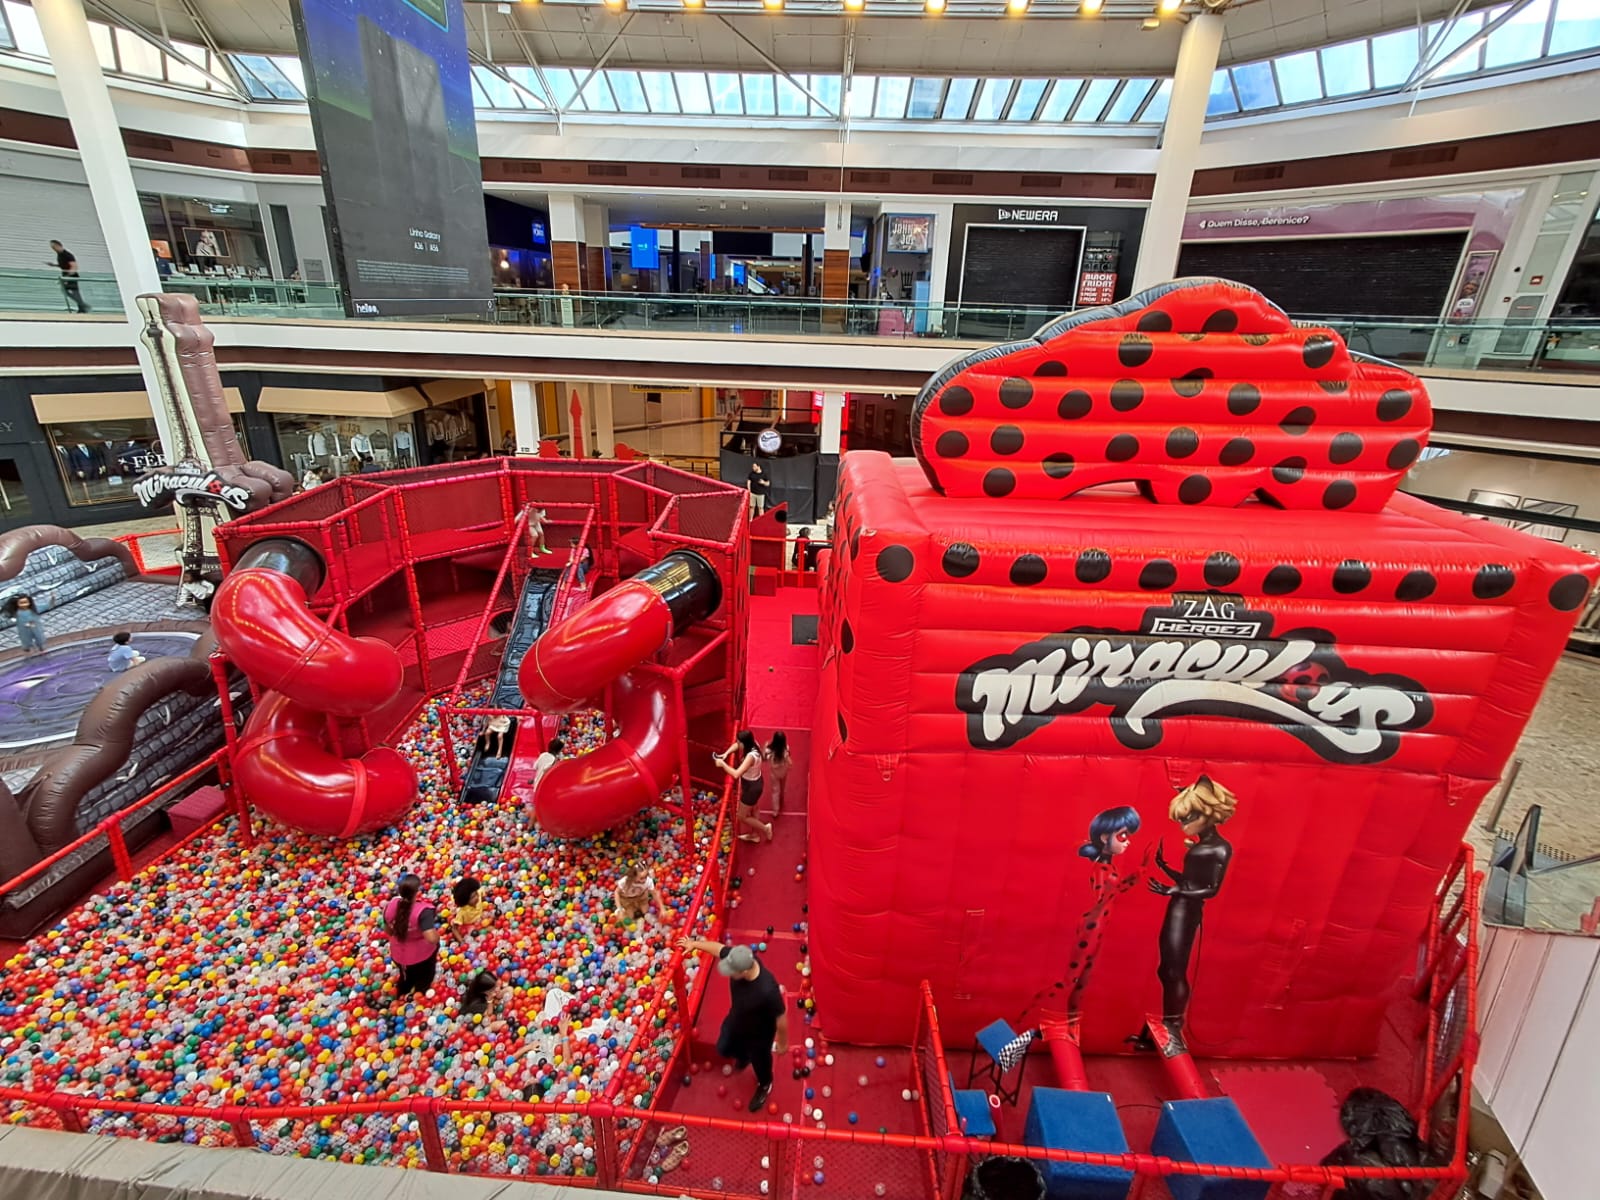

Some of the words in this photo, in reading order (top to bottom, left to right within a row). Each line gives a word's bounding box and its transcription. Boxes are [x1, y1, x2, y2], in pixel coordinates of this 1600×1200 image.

[1207, 220, 1232, 228] Quem
[1261, 215, 1310, 226] Berenice?
[1183, 595, 1236, 620] ZAG
[1158, 623, 1253, 635] HEROEZ
[972, 637, 1416, 754] Miraculous
